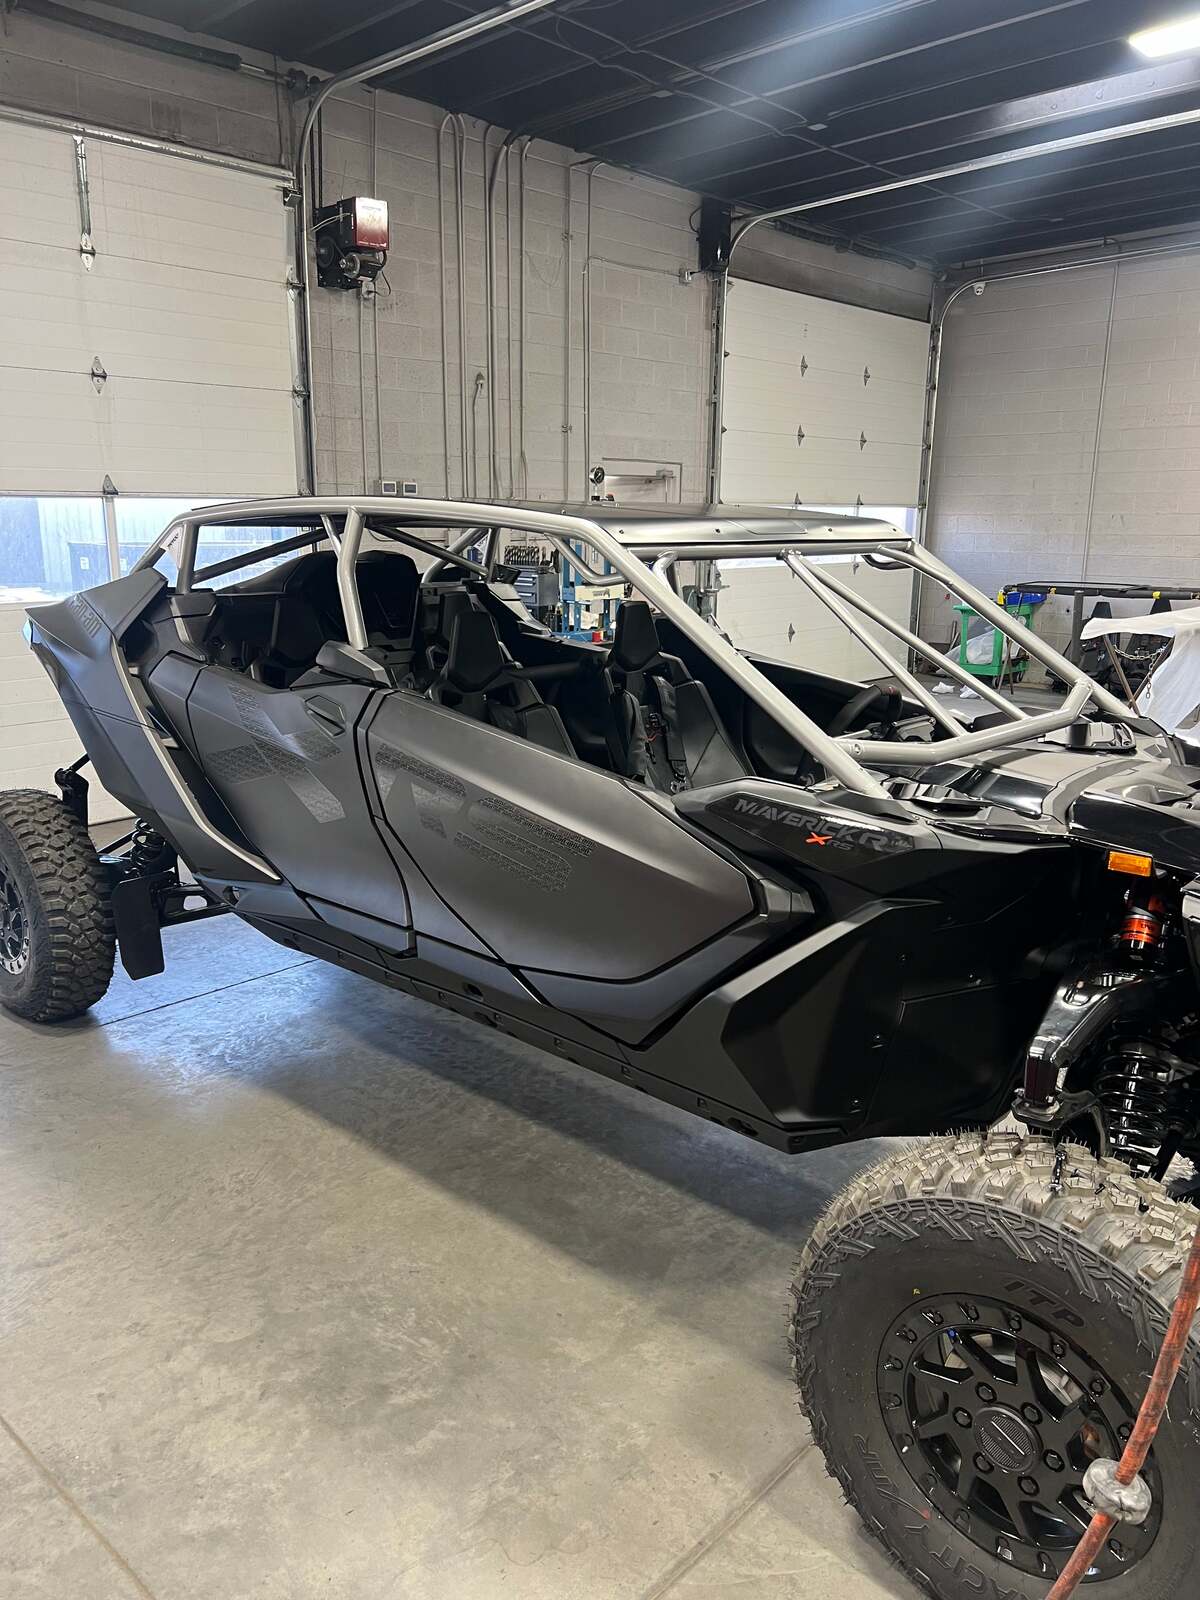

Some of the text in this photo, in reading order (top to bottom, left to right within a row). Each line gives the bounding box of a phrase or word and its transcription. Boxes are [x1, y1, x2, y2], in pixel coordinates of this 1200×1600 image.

[734, 799, 859, 842] MAVERICK
[1003, 1280, 1085, 1327] ITP
[902, 1523, 1034, 1600] ACITY
